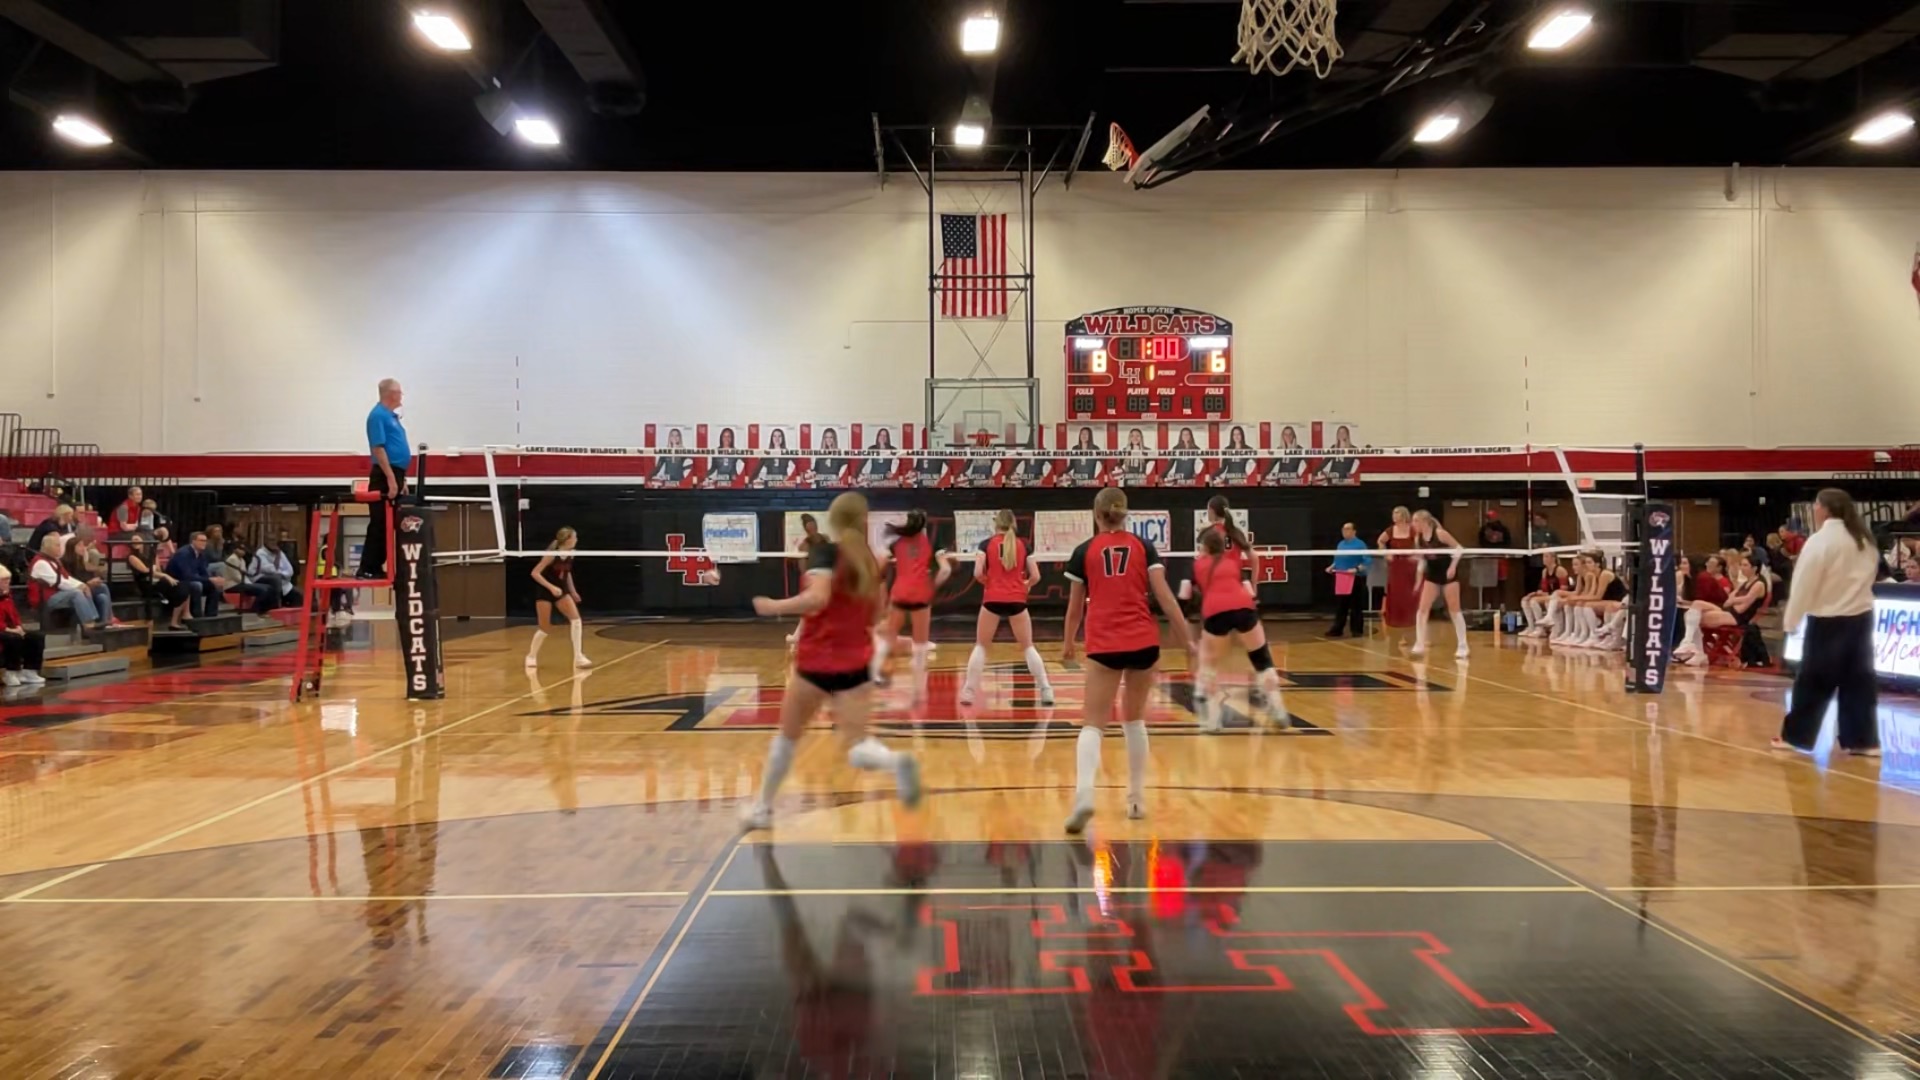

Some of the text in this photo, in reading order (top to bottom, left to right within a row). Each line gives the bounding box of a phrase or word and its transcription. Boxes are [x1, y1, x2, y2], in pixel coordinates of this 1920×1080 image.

[1123, 307, 1146, 315] HOME
[1083, 314, 1216, 335] WILDCATS
[1141, 337, 1180, 360] 1:00
[1092, 350, 1107, 373] 8
[1118, 361, 1141, 385] LH
[1211, 350, 1226, 373] 6
[1127, 387, 1176, 395] PLAYER FOULS
[1205, 387, 1225, 395] FOULS
[1102, 546, 1132, 577] 17
[402, 543, 427, 691] WILDCATS
[1644, 538, 1670, 686] WILDCATS
